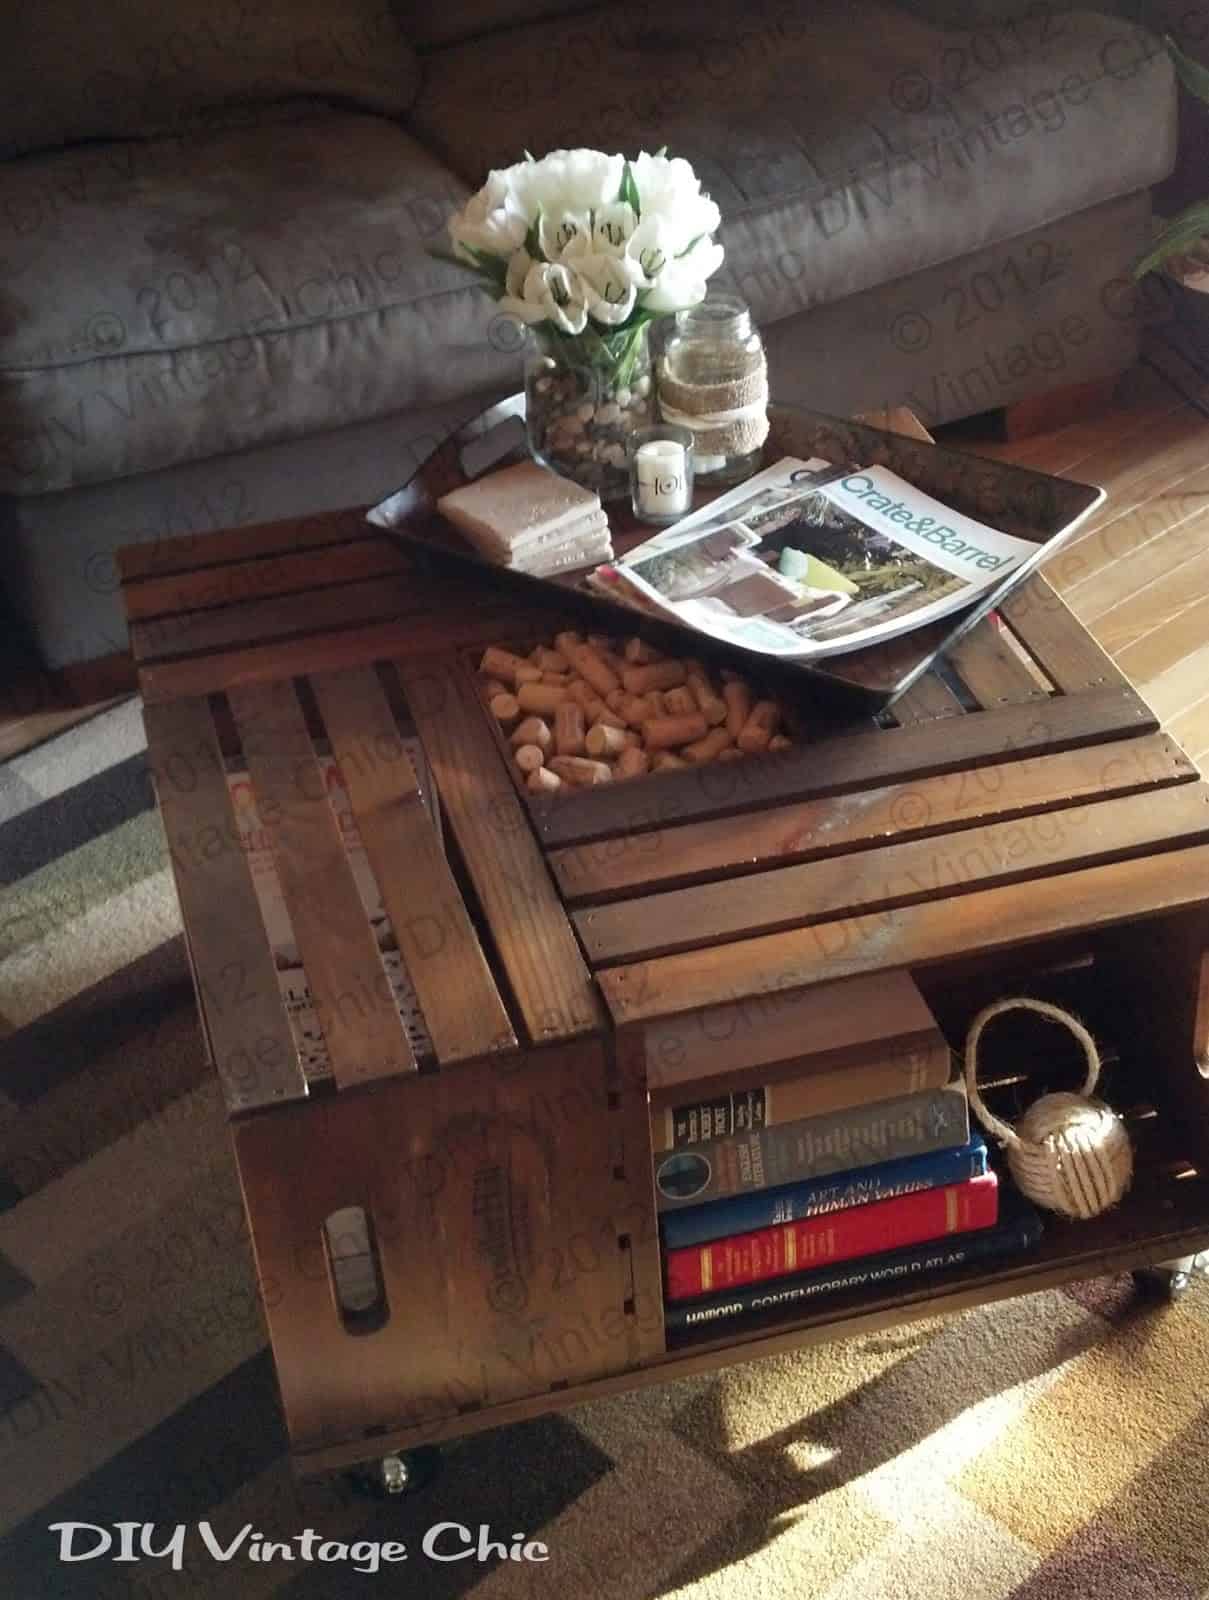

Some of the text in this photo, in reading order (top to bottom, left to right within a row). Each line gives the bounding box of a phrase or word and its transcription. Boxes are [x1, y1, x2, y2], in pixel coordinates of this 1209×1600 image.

[841, 475, 1015, 573] Crate&Barrel
[805, 1192, 870, 1217] HUMAN
[807, 1175, 881, 1203] ART AND
[751, 1273, 868, 1308] CONTEMPORARY
[870, 1261, 921, 1281] WORLD
[925, 1251, 966, 1269] ATLAS
